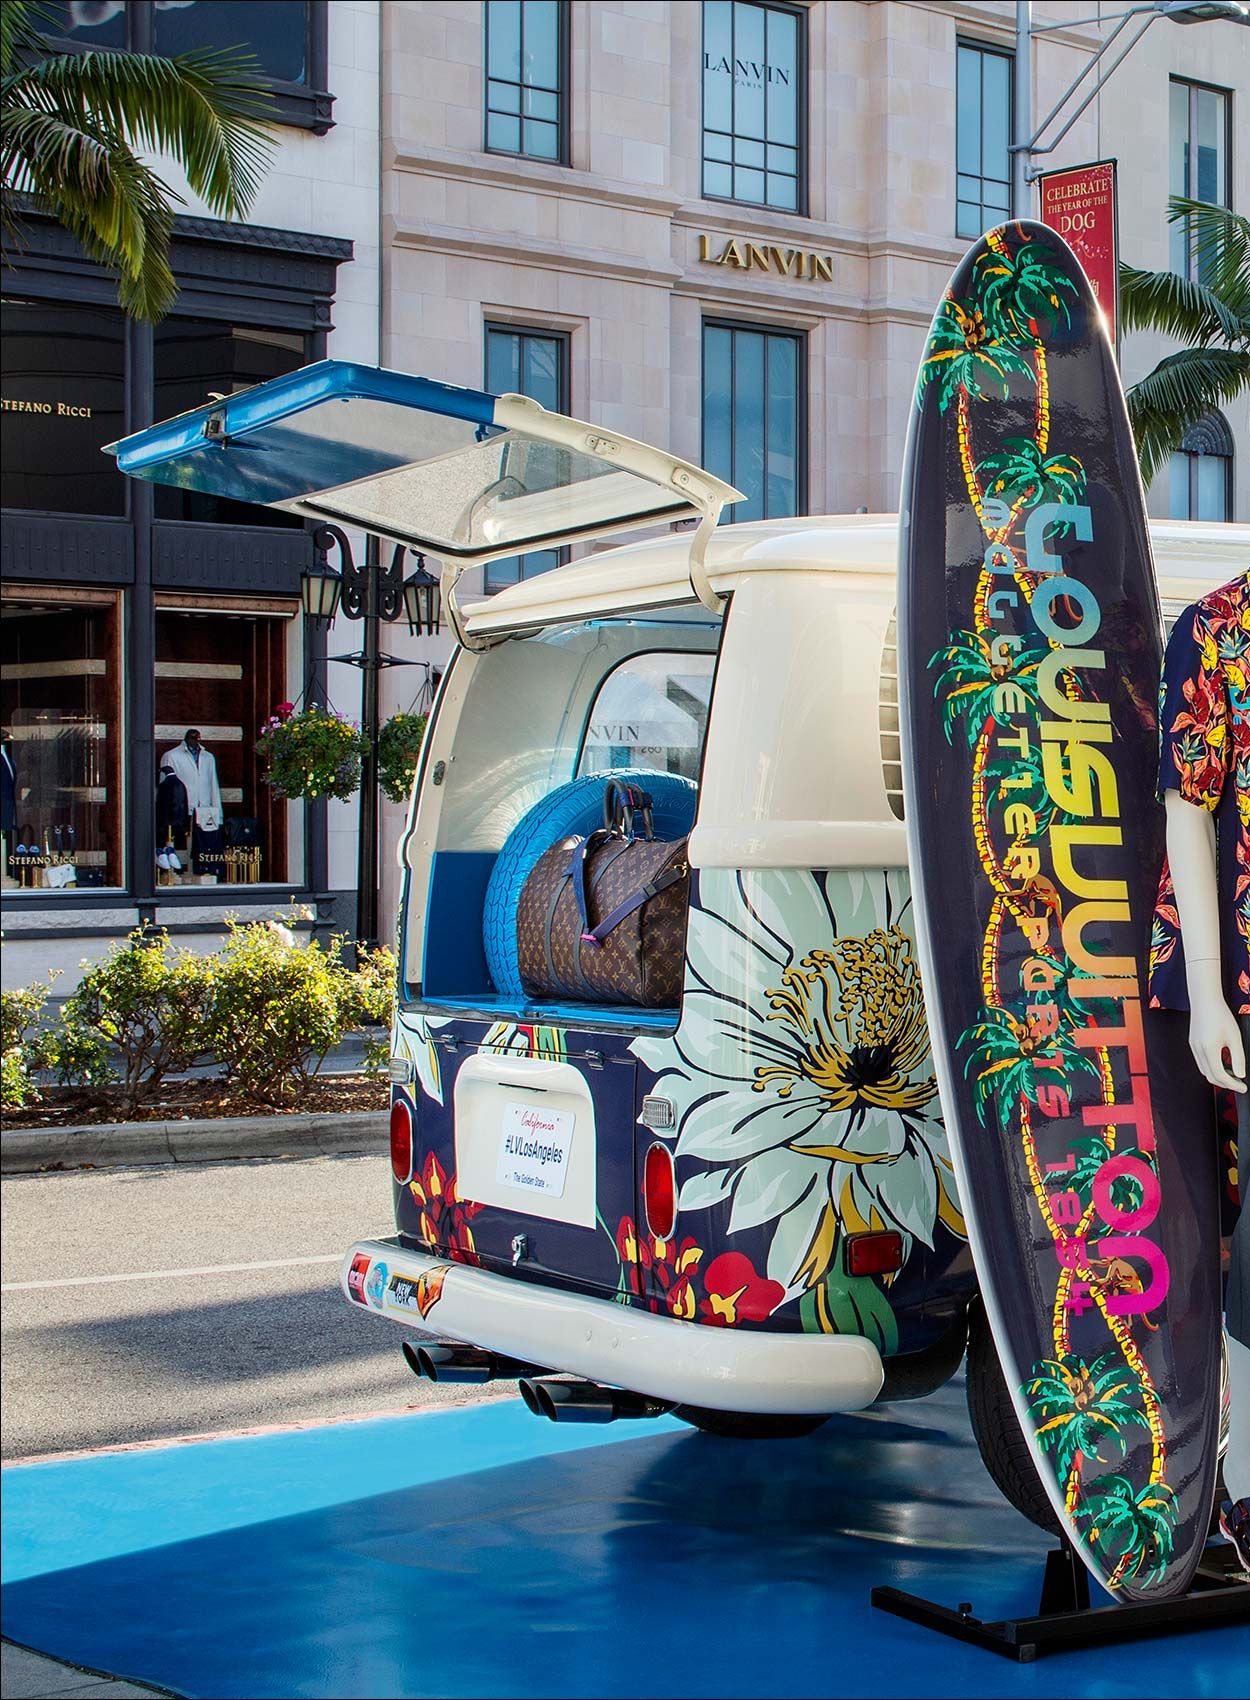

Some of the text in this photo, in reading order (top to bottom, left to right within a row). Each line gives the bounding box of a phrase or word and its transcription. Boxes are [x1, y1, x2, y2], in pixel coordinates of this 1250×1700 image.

[703, 52, 790, 85] LANVIN
[735, 79, 762, 89] PARIS
[1047, 178, 1109, 201] CELEBRATE
[1047, 195, 1108, 215] THE YEAR OF THE
[1060, 211, 1096, 233] DOG
[698, 234, 833, 282] LANVIN
[57, 402, 92, 418] RICCI
[8, 855, 79, 865] STEFANO RICCI
[504, 1134, 563, 1165] #LVLosAngeles
